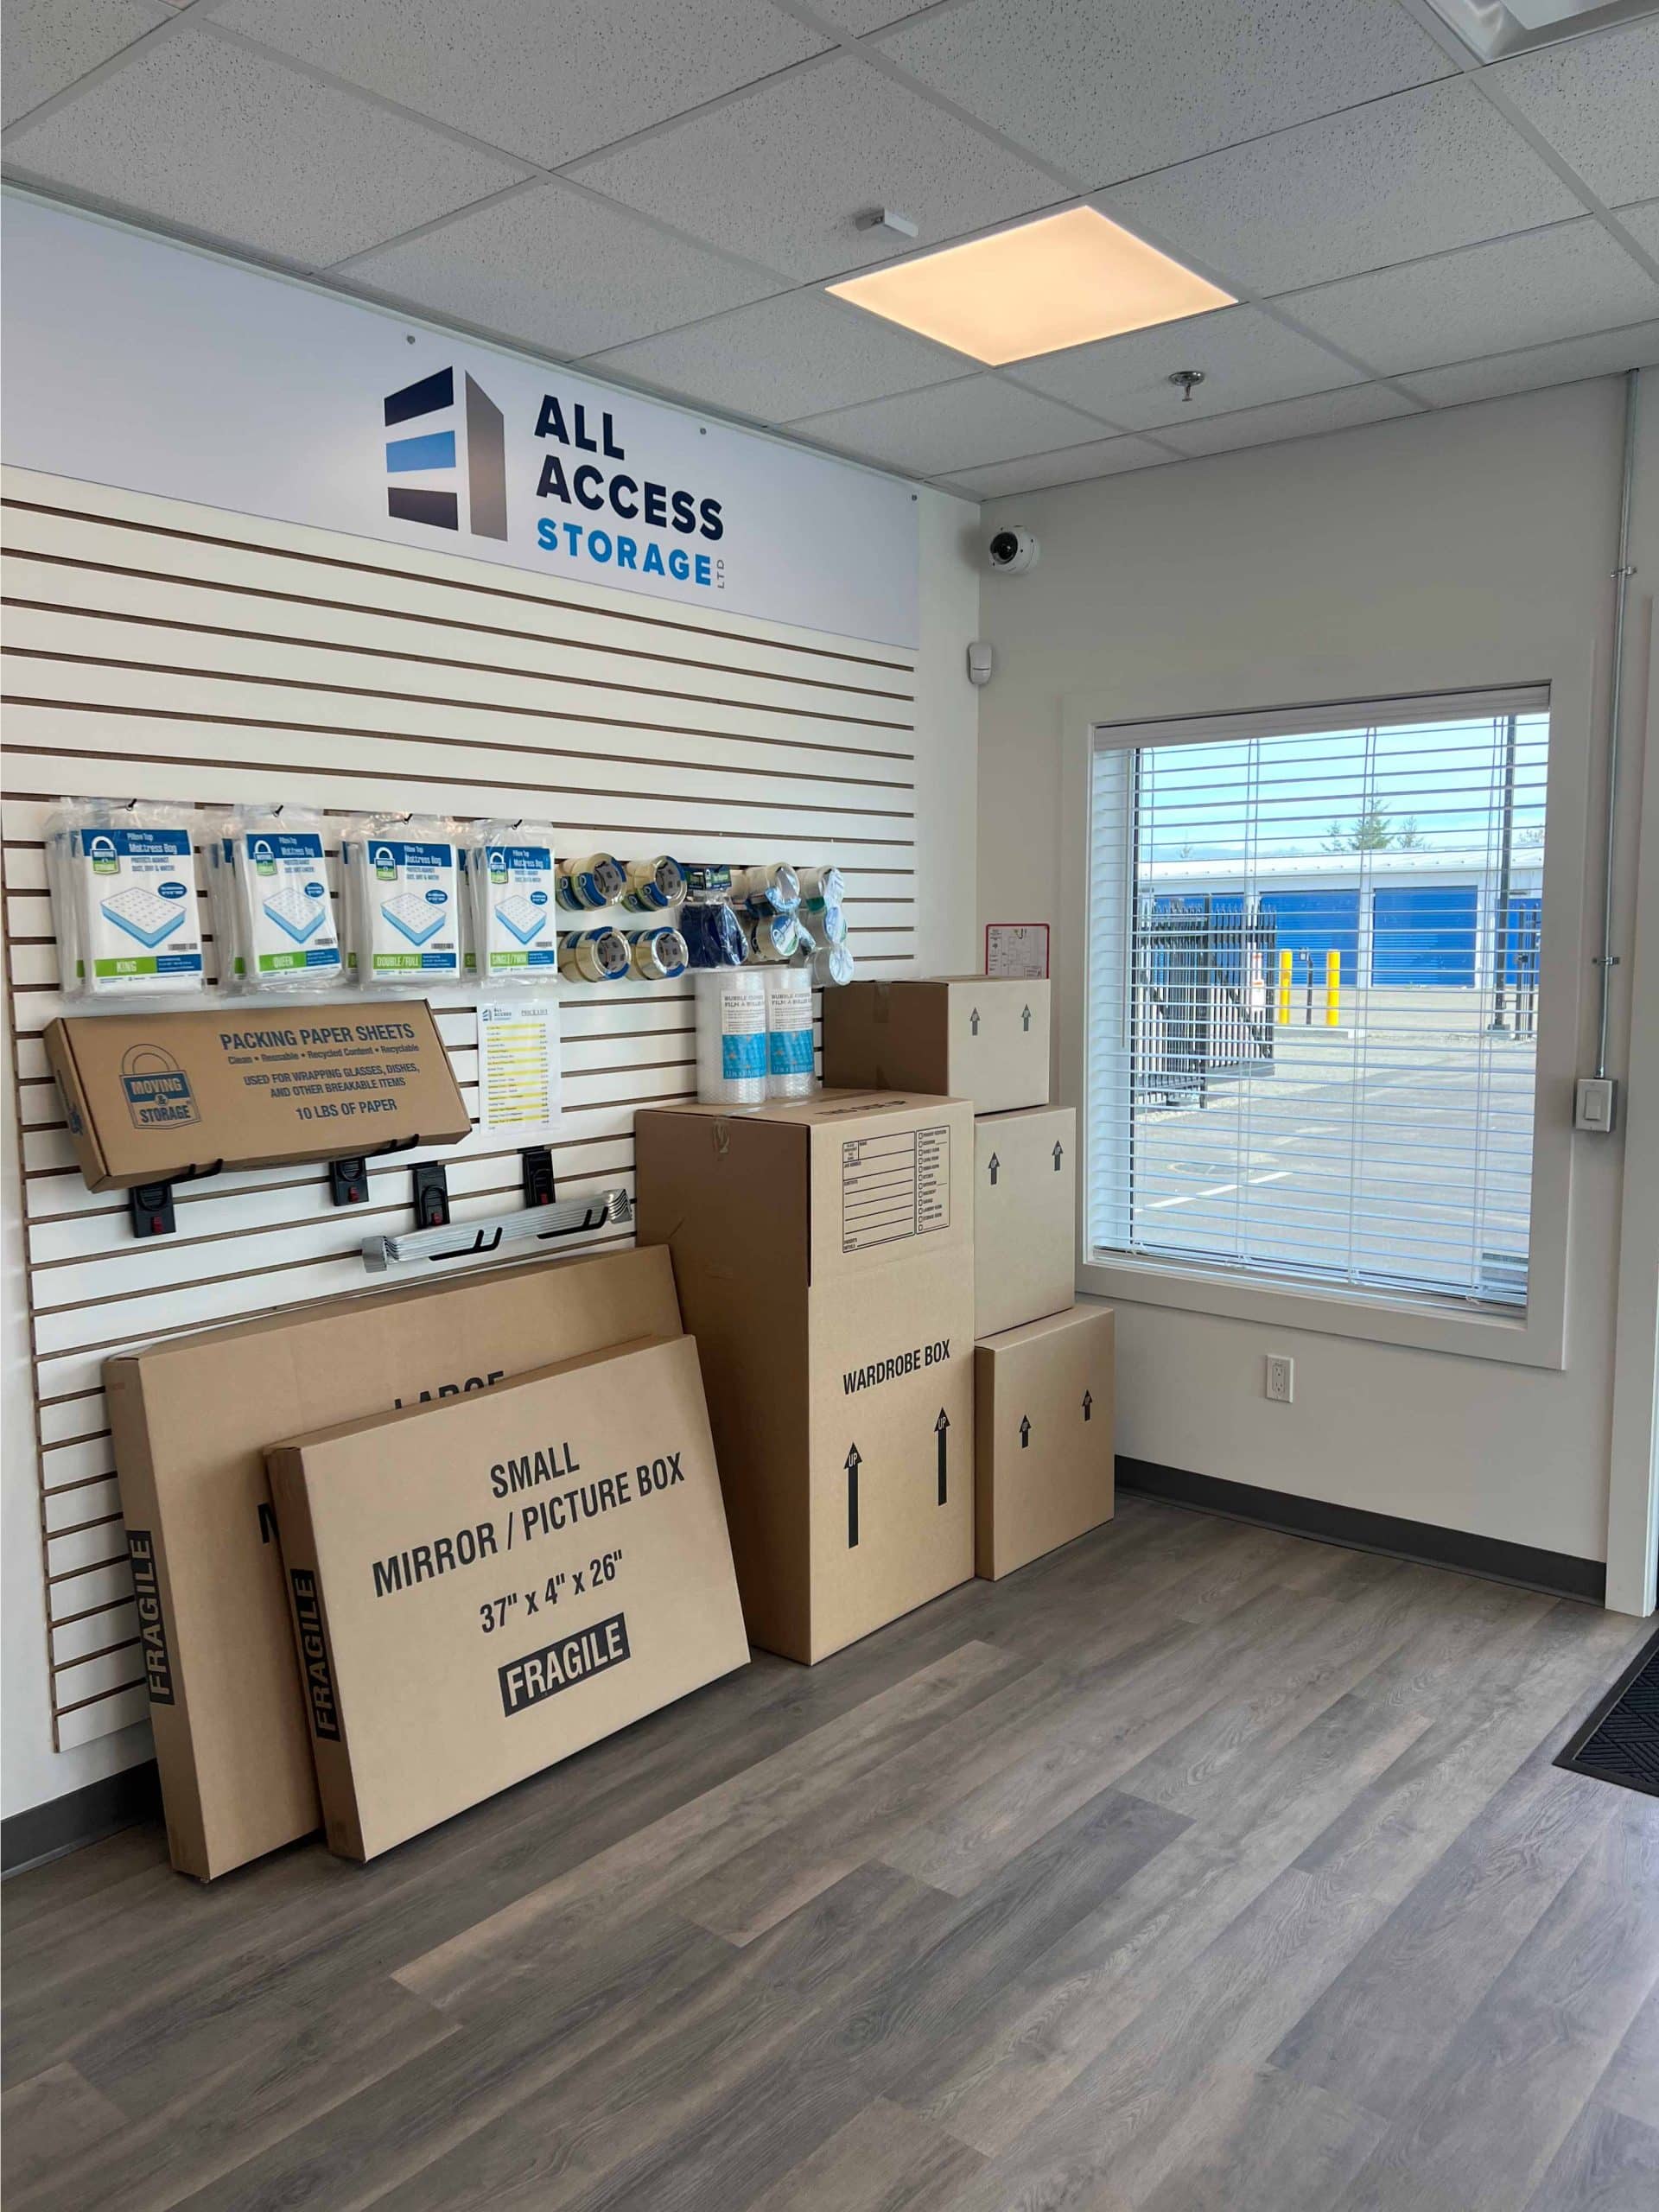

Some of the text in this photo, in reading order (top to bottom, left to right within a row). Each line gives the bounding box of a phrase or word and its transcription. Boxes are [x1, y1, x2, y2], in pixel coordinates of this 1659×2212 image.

[534, 394, 625, 460] ALL
[536, 454, 723, 541] ACCESS
[537, 517, 711, 586] STORAGE
[716, 559, 725, 588] LTD
[117, 961, 137, 973] KING
[273, 956, 293, 968] QUEEN
[377, 956, 419, 967] DOUBLE/FULL
[219, 1023, 415, 1051] PACKING PAPER SHEETS
[228, 1056, 253, 1065] Clean
[307, 1048, 343, 1059] Recycled
[343, 1046, 373, 1056] Content
[380, 1044, 420, 1054] Recyclable
[130, 1077, 183, 1095] MOVING
[244, 1063, 420, 1085] USED FOR WRAPPING GLASSES, DISHES,
[270, 1077, 406, 1098] AND OTHER BREAKABLE ITEMS
[139, 1104, 191, 1123] STORAGE
[296, 1098, 397, 1120] 10 LBS OF PAPER
[842, 1339, 950, 1395] WARDROBE BOX
[938, 1416, 946, 1430] UP
[490, 1442, 581, 1498] SMALL
[849, 1452, 858, 1467] UP
[372, 1452, 685, 1598] MIRROR / PICTURE BOX
[479, 1548, 623, 1634] 37" x 4" x 26"
[130, 1536, 171, 1696] FRAGILE
[293, 1573, 340, 1734] FRAGILE
[505, 1621, 624, 1708] FRAGILE
